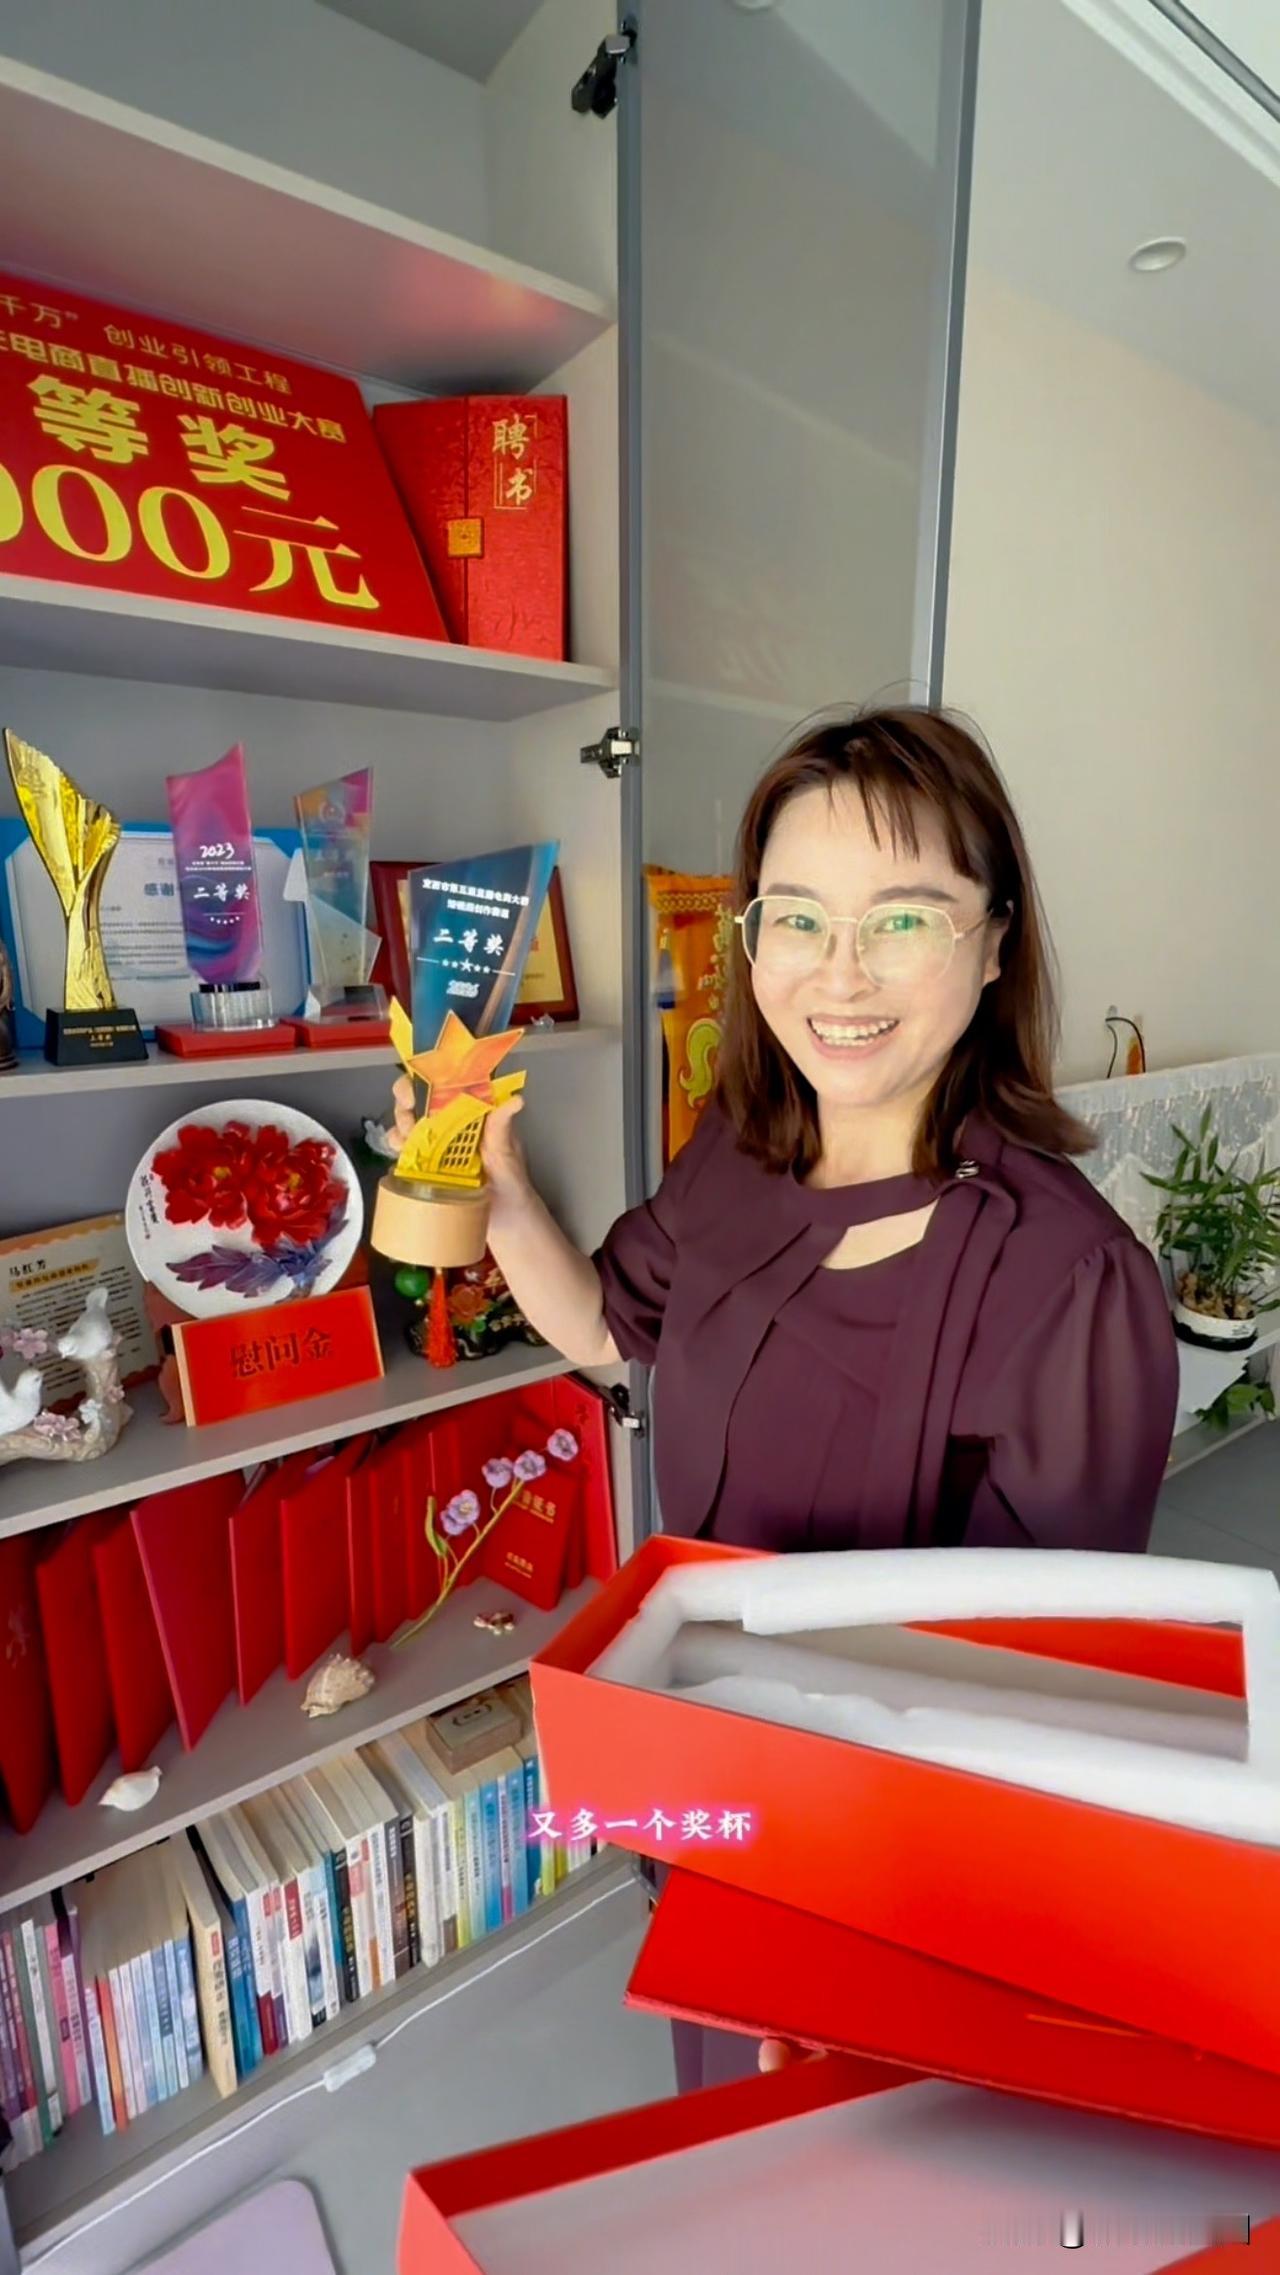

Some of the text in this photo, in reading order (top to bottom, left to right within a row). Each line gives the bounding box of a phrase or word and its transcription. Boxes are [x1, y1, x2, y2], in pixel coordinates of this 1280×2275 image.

[103, 323, 293, 396] 创业引领工程
[27, 373, 291, 502] 等奖
[492, 413, 534, 506] 聘书
[0, 462, 381, 611] 00元
[200, 842, 235, 860] 2023
[193, 882, 250, 902] 二等奖
[433, 928, 505, 956] 二等奖
[230, 1326, 333, 1378] 慰问金
